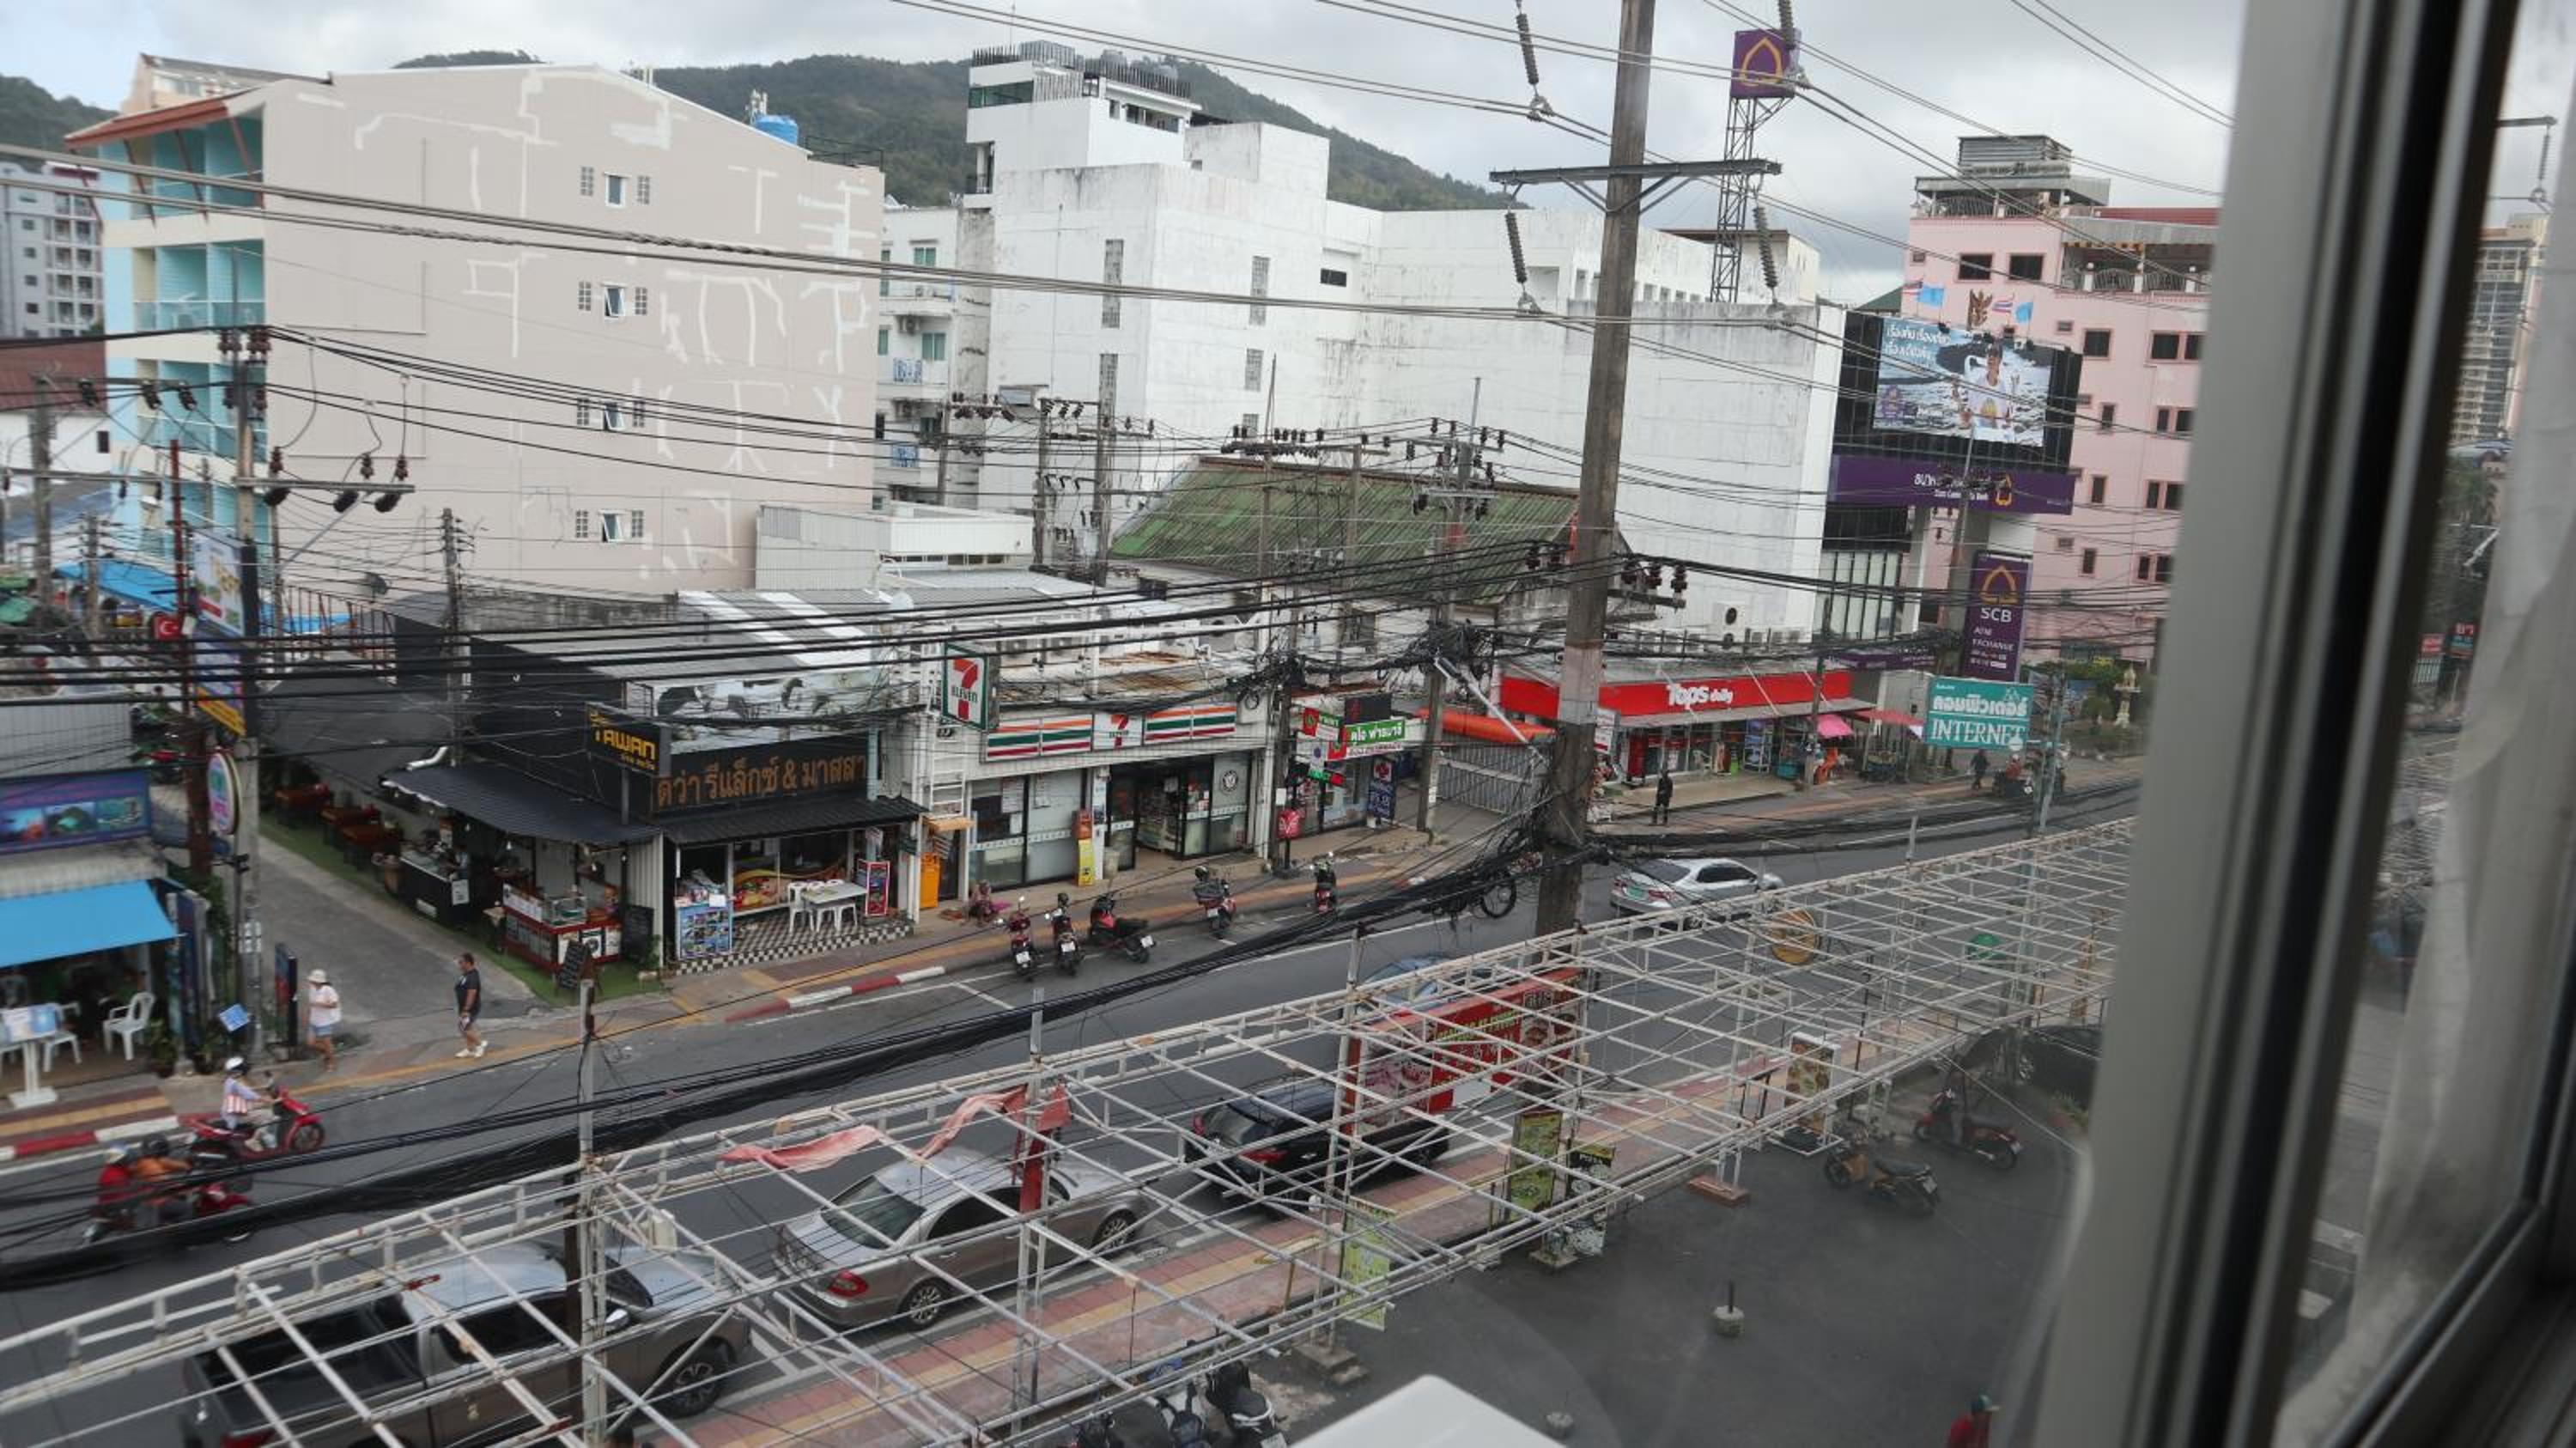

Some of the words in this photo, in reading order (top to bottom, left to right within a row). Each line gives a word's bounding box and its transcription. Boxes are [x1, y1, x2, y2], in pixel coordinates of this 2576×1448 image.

[1980, 606, 2013, 624] SCB
[952, 657, 978, 720] 7
[1667, 684, 1710, 710] Tops
[1930, 718, 2026, 746] INTERNET
